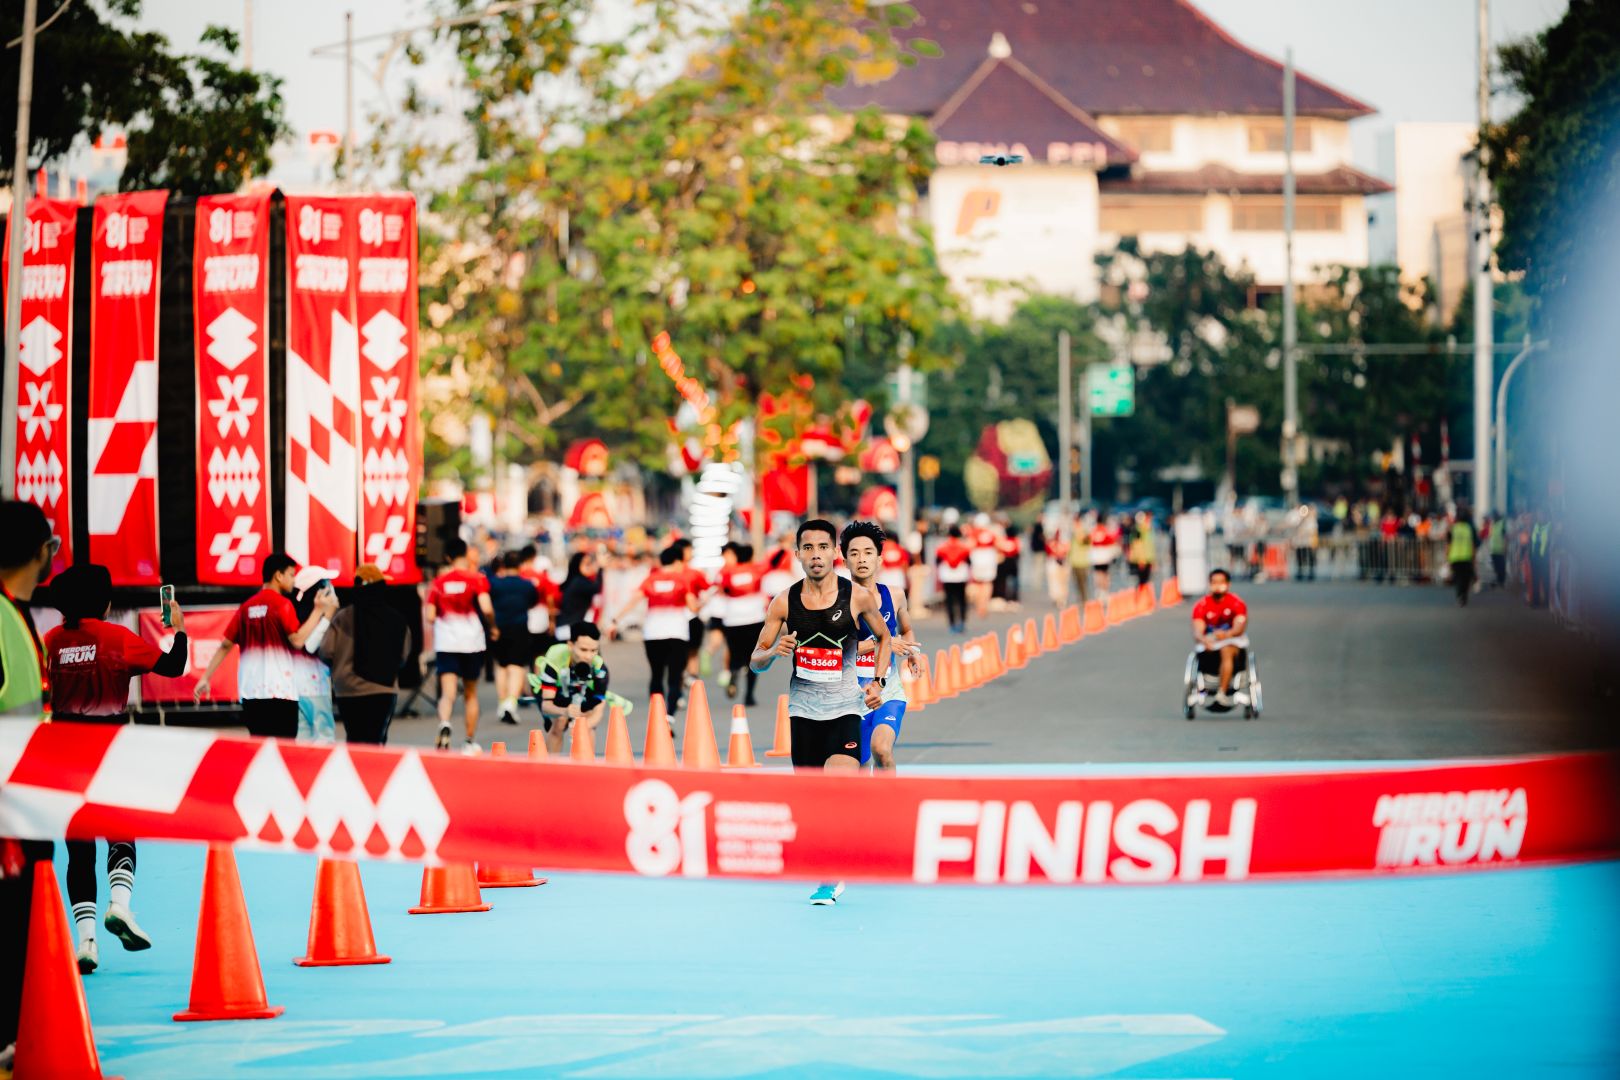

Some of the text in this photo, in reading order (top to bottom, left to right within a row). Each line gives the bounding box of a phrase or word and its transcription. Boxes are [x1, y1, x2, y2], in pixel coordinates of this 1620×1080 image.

[58, 644, 96, 654] MERDEKA
[64, 651, 96, 664] RUN
[800, 656, 838, 667] M-83669
[1373, 787, 1528, 827] MERDEKA
[623, 778, 713, 878] 81
[912, 798, 1257, 884] FINISH
[1400, 818, 1528, 866] RUN
